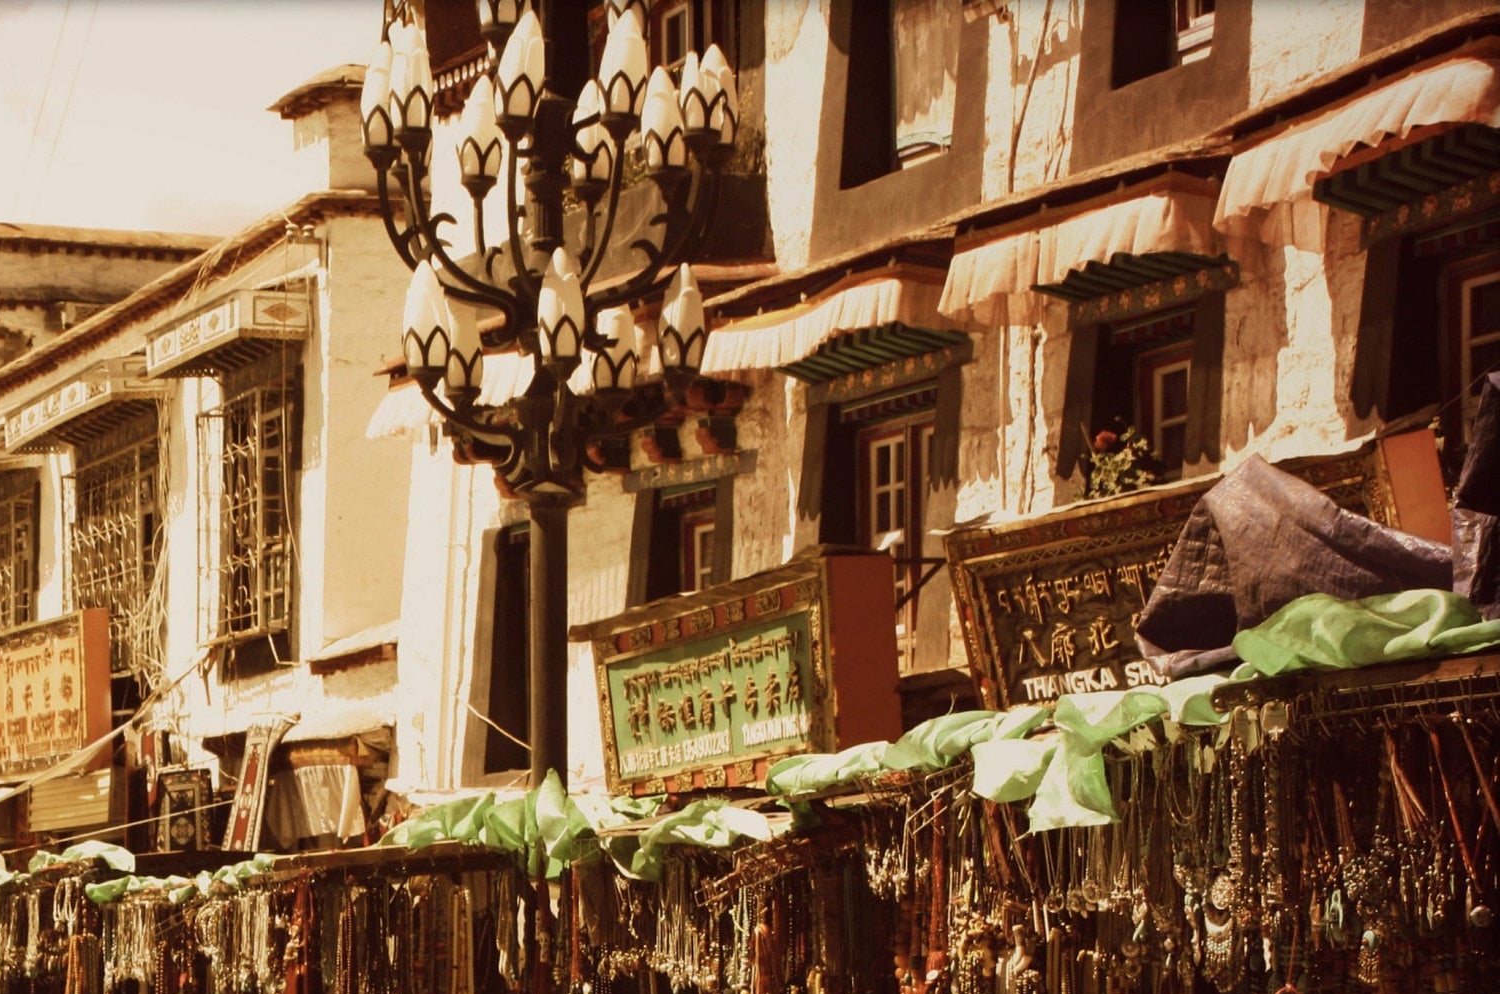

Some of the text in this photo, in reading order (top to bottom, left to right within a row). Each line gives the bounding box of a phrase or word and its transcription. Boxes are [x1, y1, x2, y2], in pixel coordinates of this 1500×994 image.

[1018, 612, 1141, 670] 八廓北
[1022, 667, 1117, 701] THANGKA
